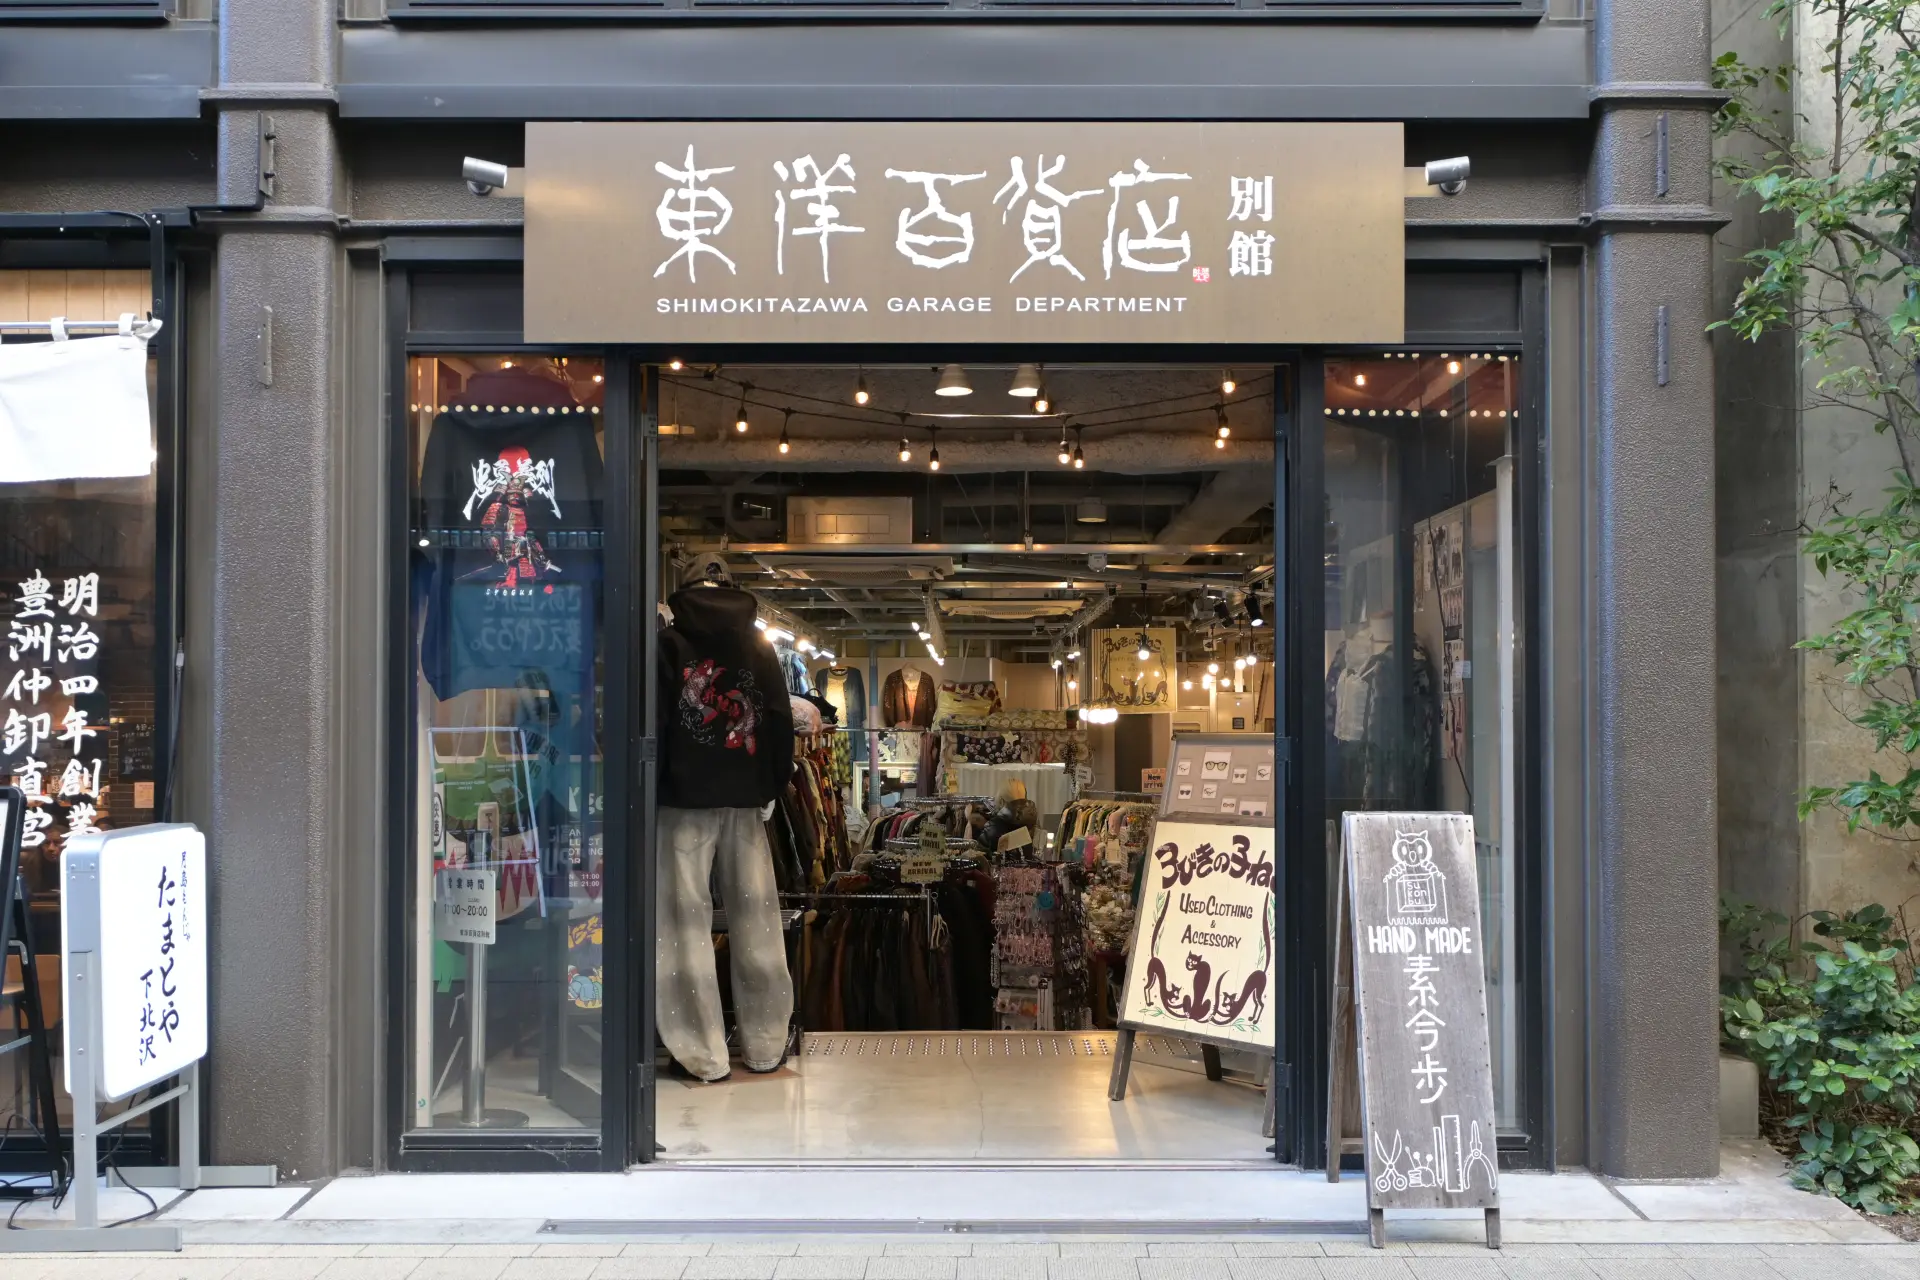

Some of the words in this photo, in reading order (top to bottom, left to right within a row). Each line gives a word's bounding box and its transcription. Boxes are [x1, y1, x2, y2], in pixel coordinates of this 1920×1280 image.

[653, 144, 1192, 284] 東洋百貨店
[1227, 175, 1276, 277] 別館
[656, 297, 869, 313] SHIMOKITAZAWA
[886, 296, 992, 312] GARAGE
[1015, 296, 1188, 312] DEPARTMENT
[158, 865, 179, 1043] たまとや
[1210, 920, 1216, 928] &
[1367, 925, 1417, 954] HAND
[1425, 926, 1472, 954] MADE
[139, 969, 157, 1066] 下北沢
[1403, 954, 1448, 1104] 素今歩
